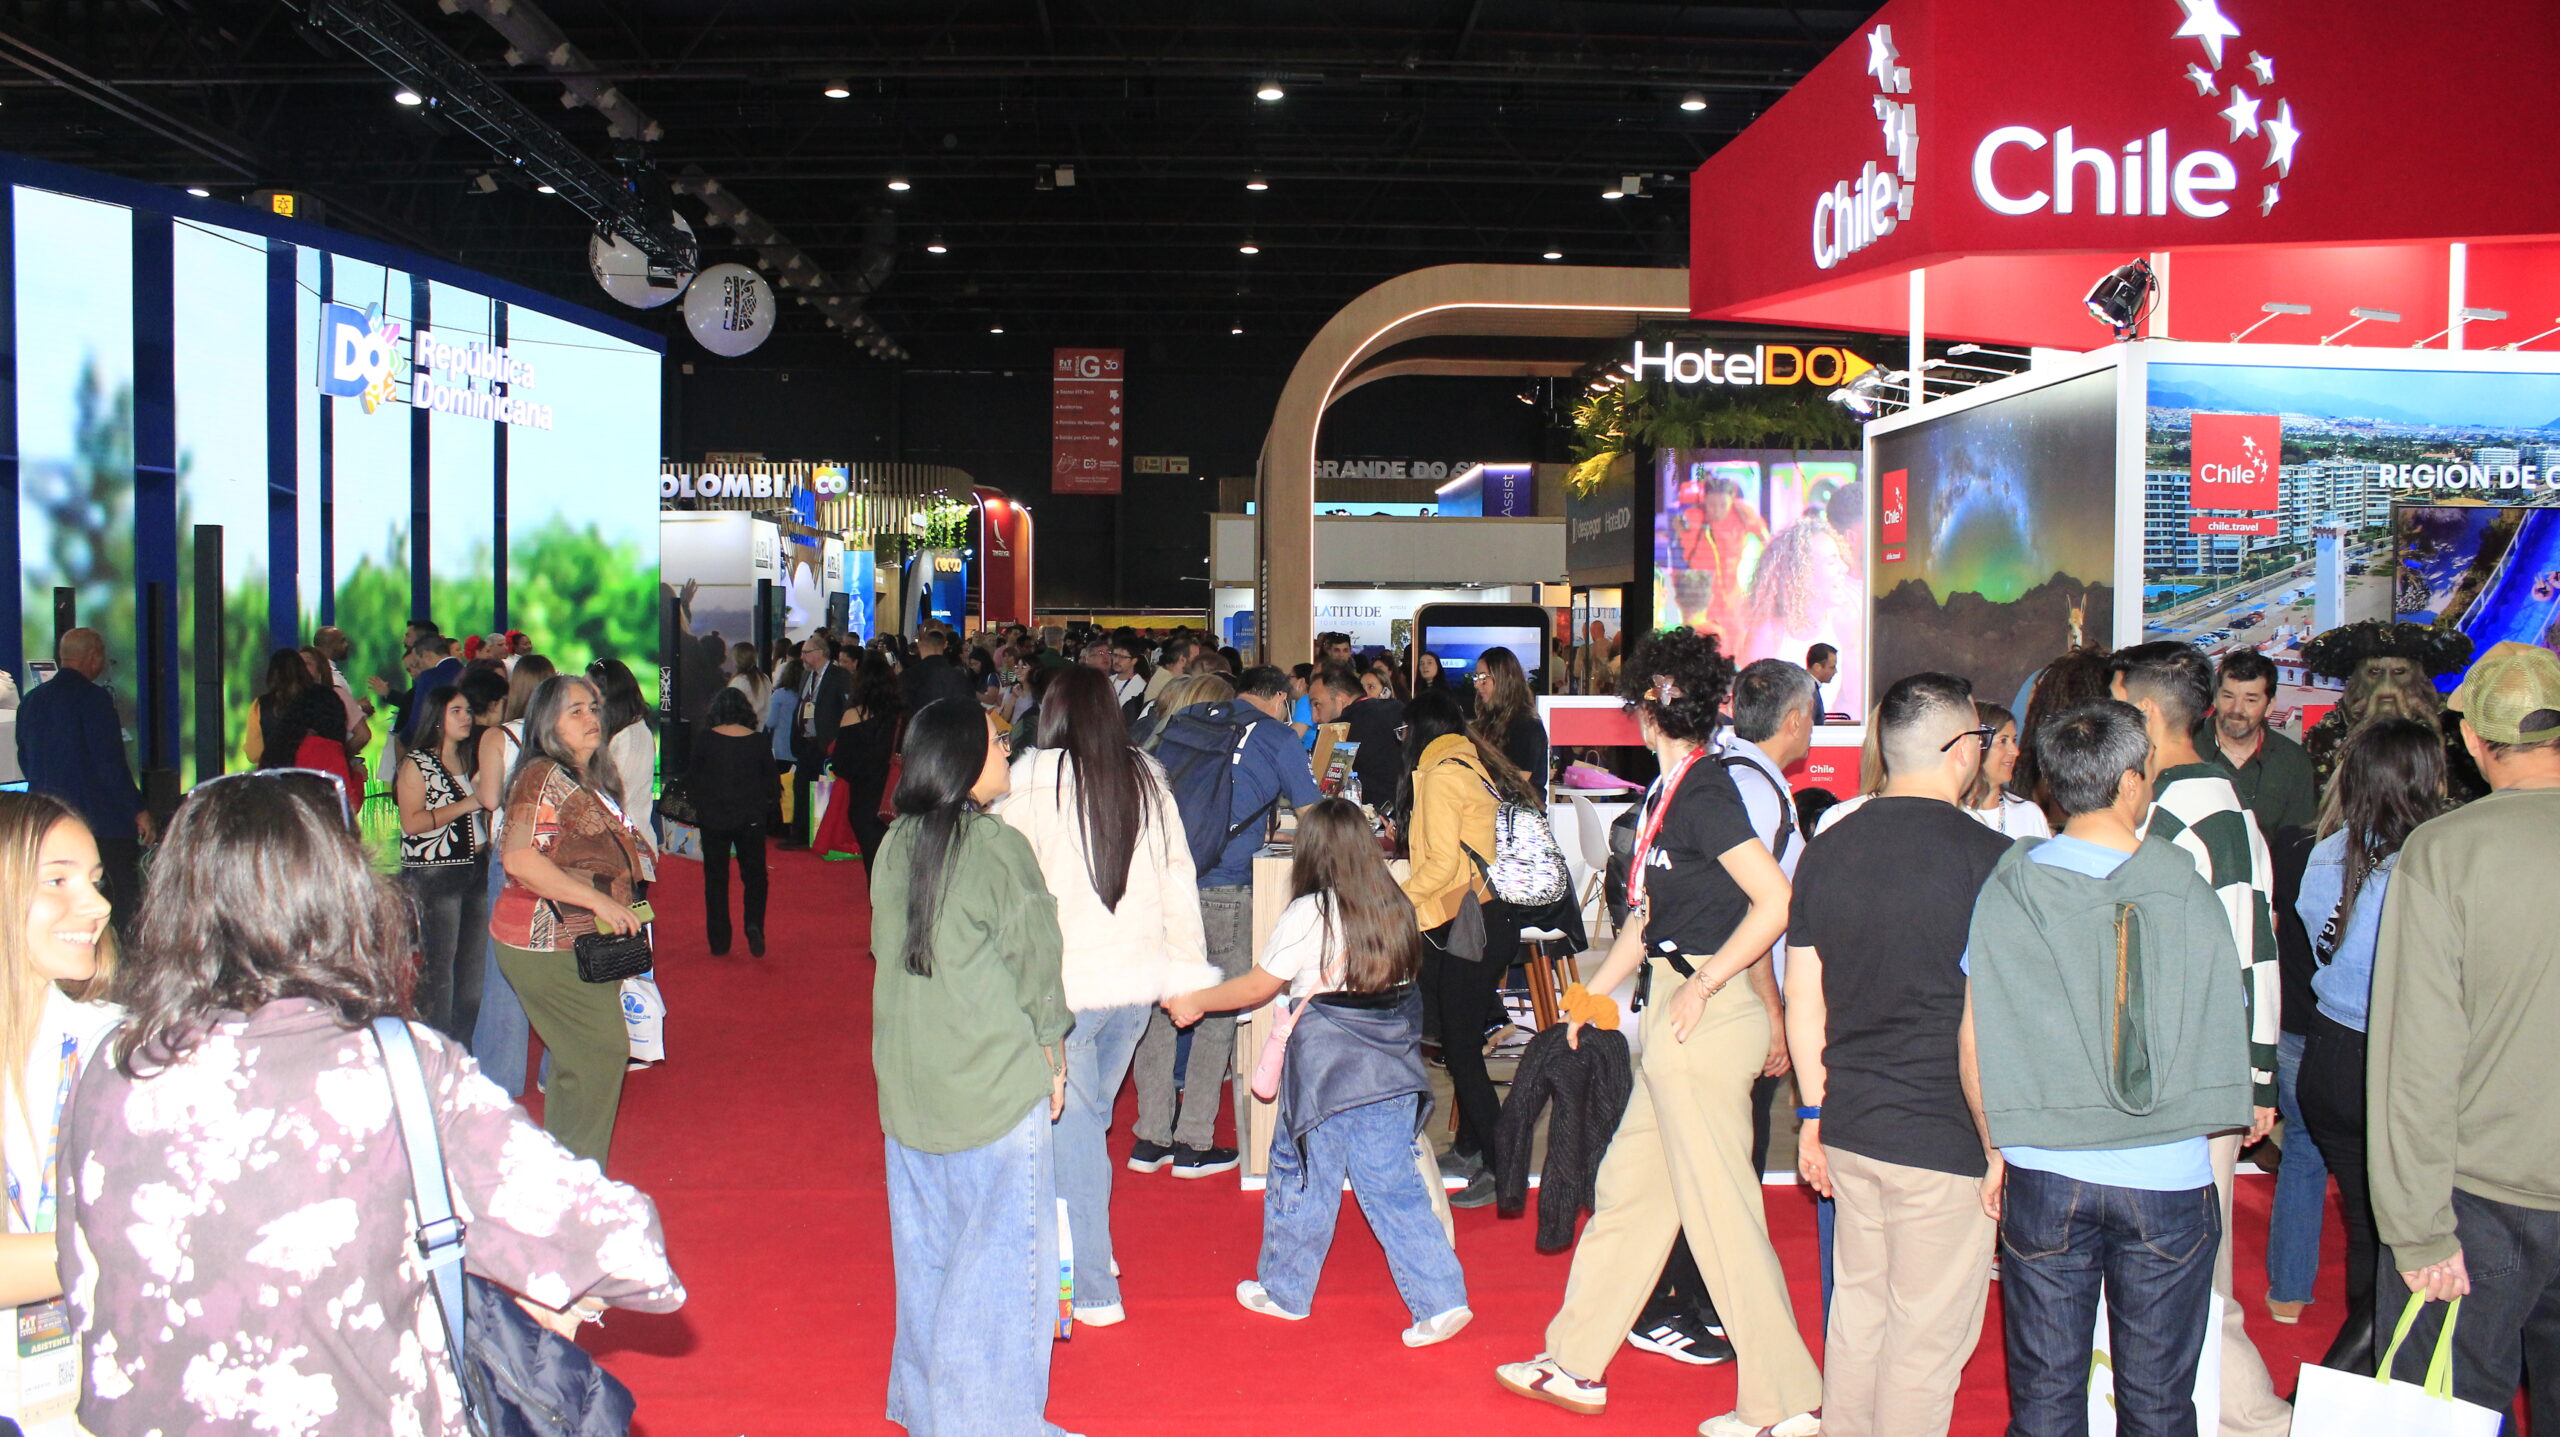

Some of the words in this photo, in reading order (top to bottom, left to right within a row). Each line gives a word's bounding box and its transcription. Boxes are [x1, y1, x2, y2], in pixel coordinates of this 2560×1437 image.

[1971, 125, 2238, 219] Chile
[1813, 161, 1899, 270] Chile
[723, 276, 732, 331] AVRIL
[334, 322, 390, 384] DO
[415, 329, 536, 389] República
[1104, 359, 1119, 370] 30
[1634, 340, 1845, 386] HotelDO
[1081, 355, 1101, 378] G
[412, 373, 553, 431] Dominicana
[1413, 461, 1448, 479] DO
[2200, 463, 2256, 484] Chile
[2379, 458, 2490, 489] REGIÓN
[2500, 465, 2537, 489] DE
[661, 473, 801, 498] OLOMBI
[815, 475, 848, 495] CO
[1502, 474, 1515, 518] Assist
[1884, 509, 1899, 525] Chile
[2208, 521, 2259, 532] chile.travel
[1314, 605, 1382, 618] LATITUDE
[1809, 765, 1835, 773] Chile
[31, 1336, 71, 1353] ASISTENTE
